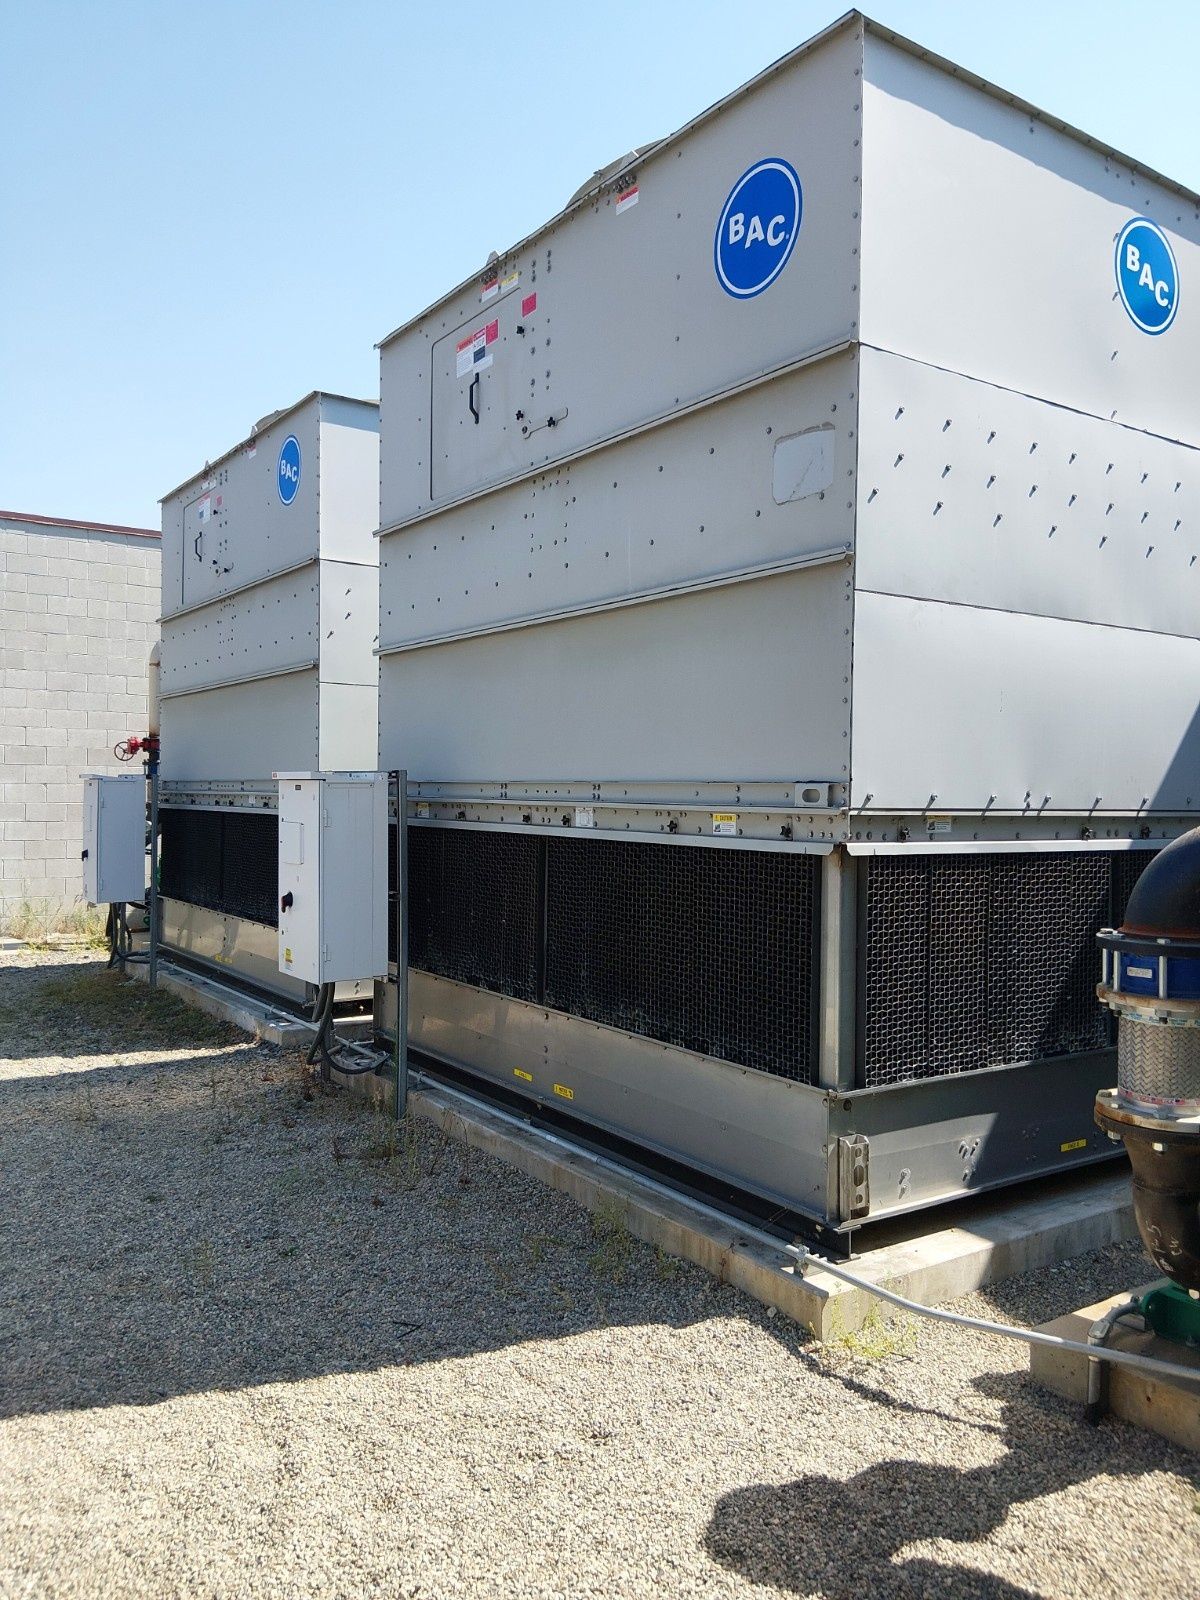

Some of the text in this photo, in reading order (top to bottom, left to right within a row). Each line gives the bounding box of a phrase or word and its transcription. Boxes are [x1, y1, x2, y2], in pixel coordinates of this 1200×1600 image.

[729, 212, 786, 250] BAC
[1126, 243, 1169, 307] BAC
[281, 459, 298, 482] BAC
